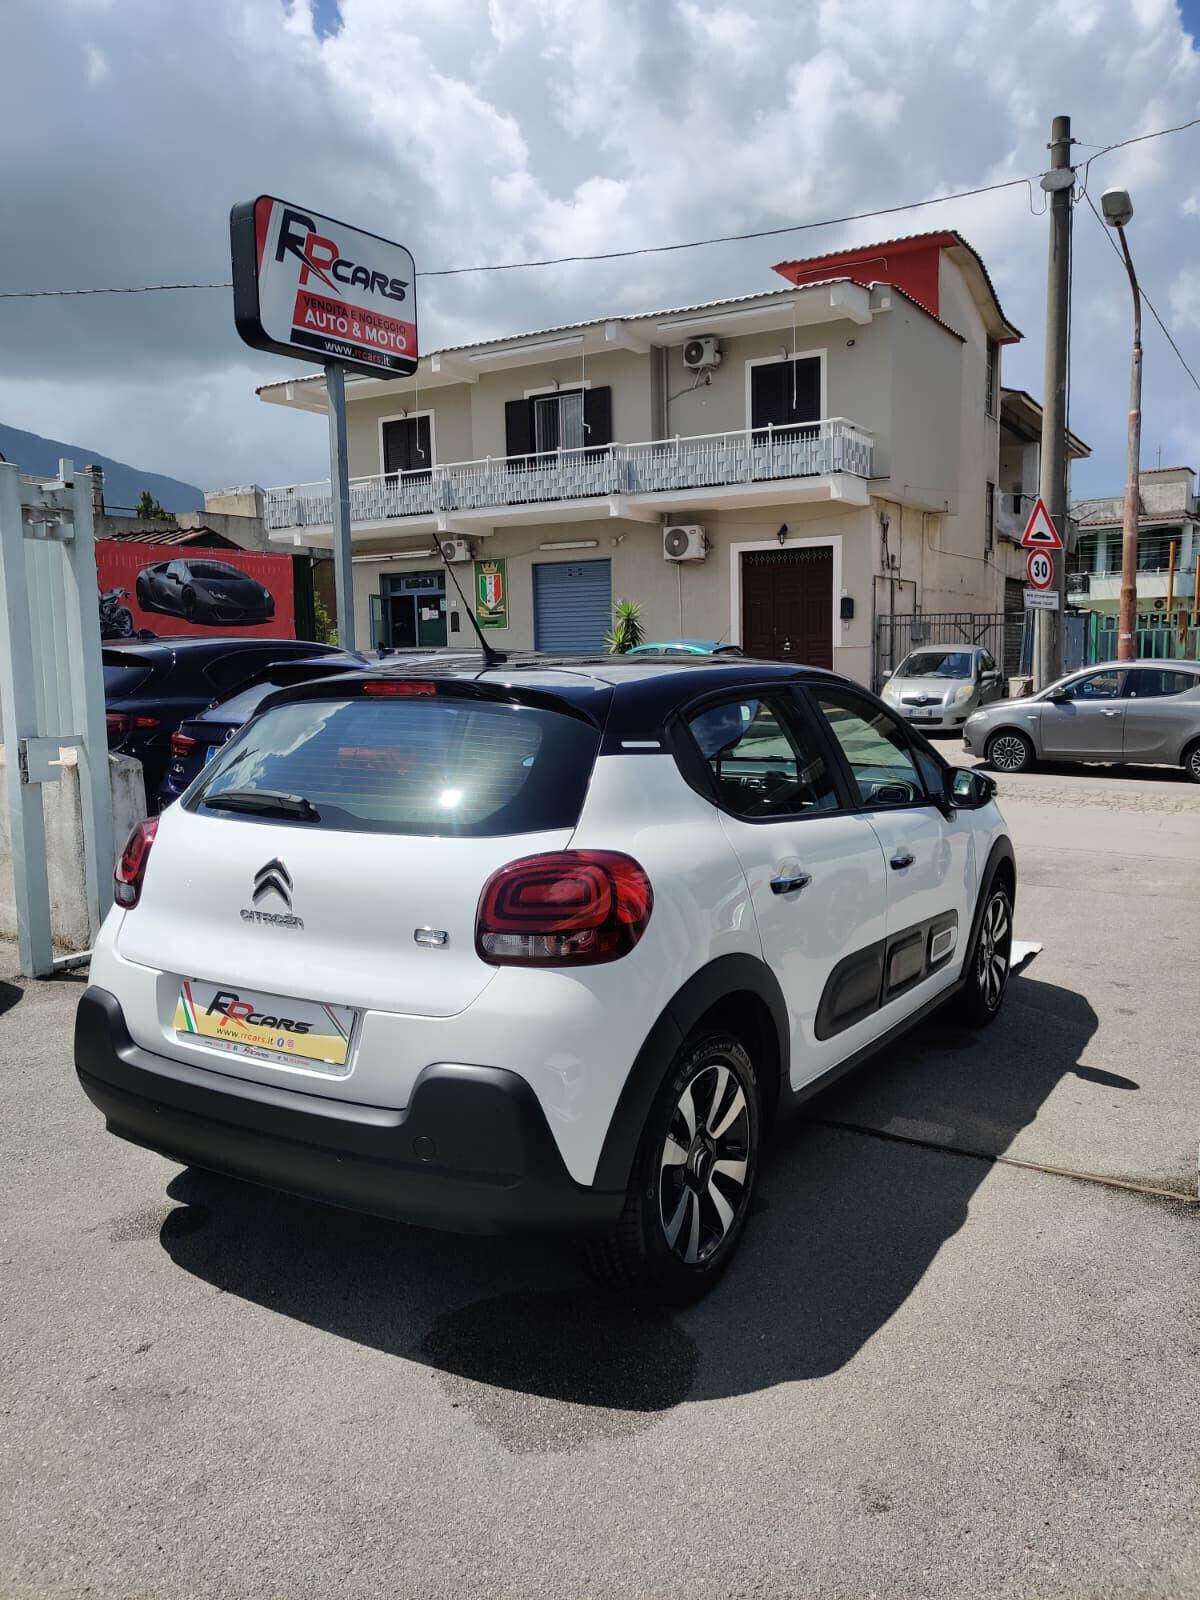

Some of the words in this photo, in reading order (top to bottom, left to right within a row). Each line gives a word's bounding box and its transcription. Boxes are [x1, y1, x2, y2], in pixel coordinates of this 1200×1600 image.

[303, 295, 348, 318] VENDITA
[350, 310, 358, 320] E
[359, 312, 406, 336] NOLEGGIO
[304, 308, 348, 334] AUTO
[352, 323, 361, 338] &
[365, 326, 407, 350] MOTO
[324, 340, 391, 367] www.rrcars.it
[1033, 560, 1048, 578] 30
[216, 1026, 274, 1045] www.rrcars.it
